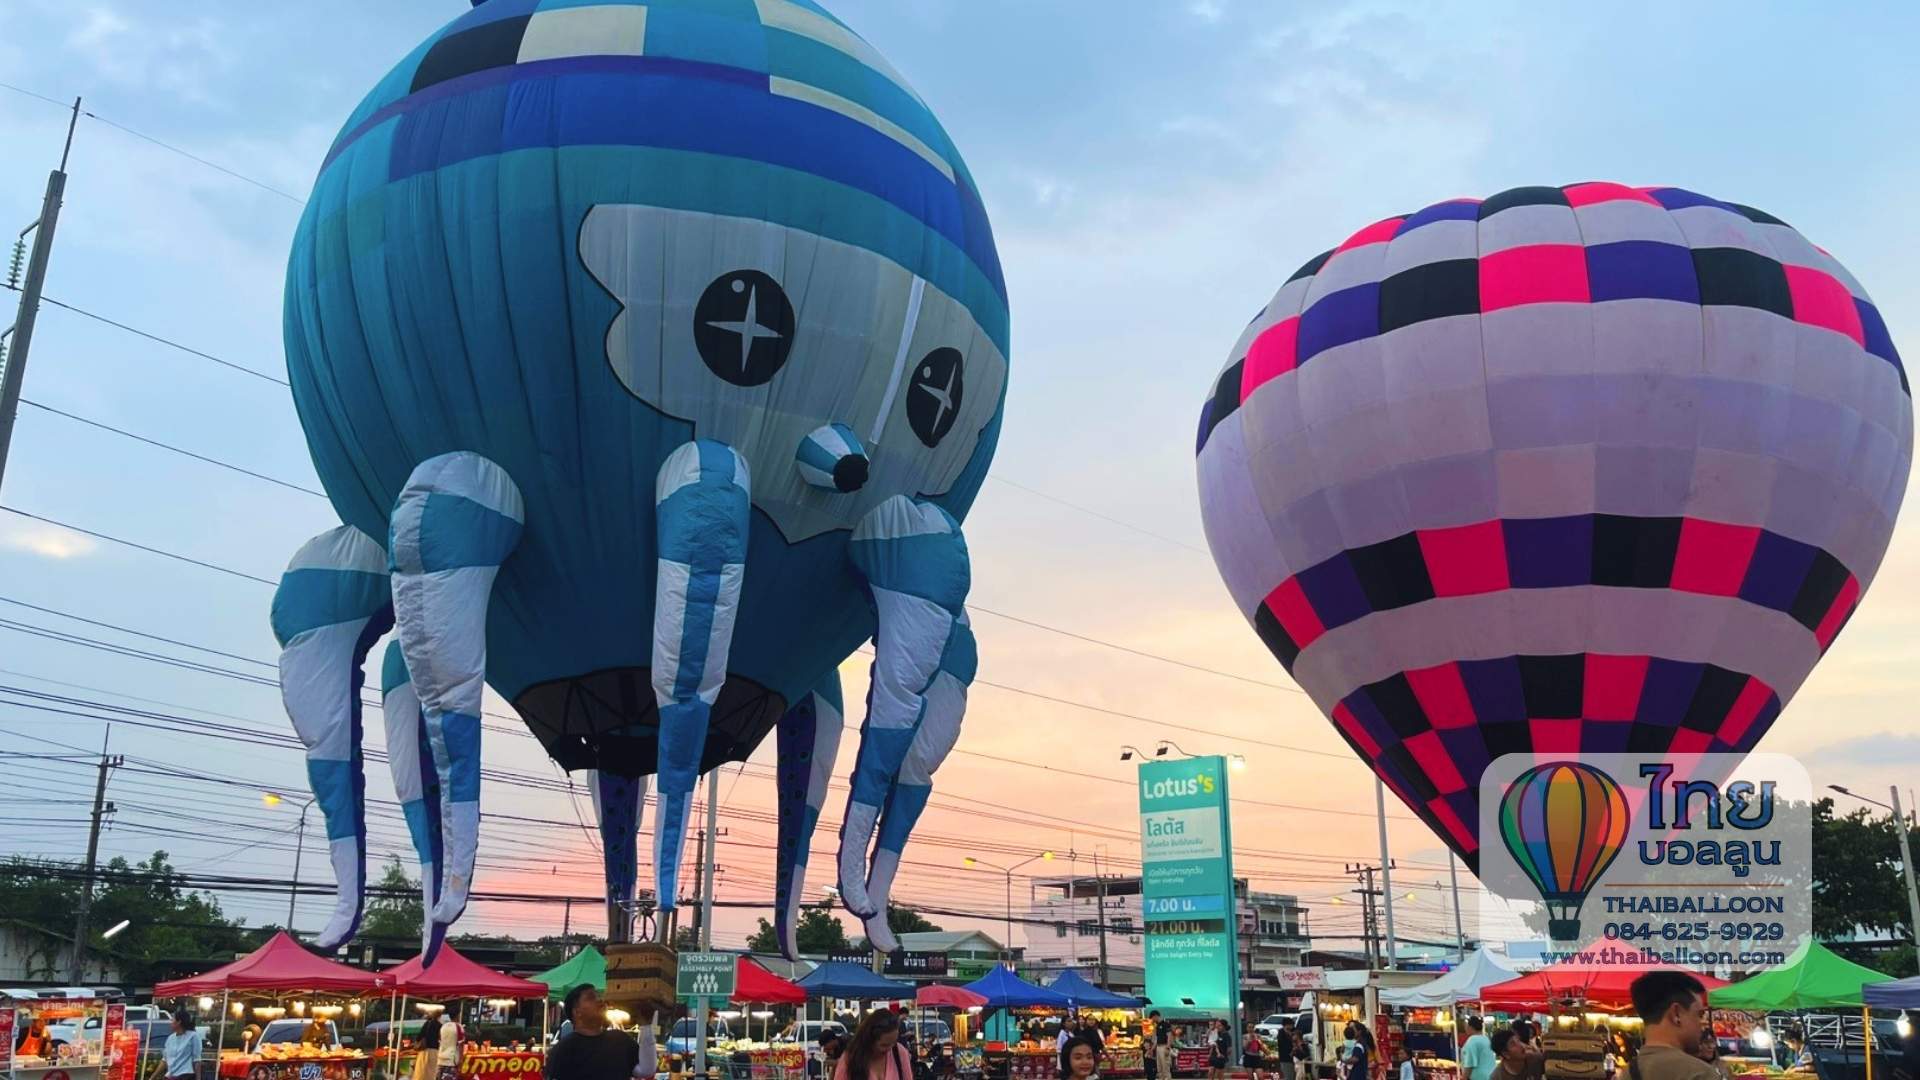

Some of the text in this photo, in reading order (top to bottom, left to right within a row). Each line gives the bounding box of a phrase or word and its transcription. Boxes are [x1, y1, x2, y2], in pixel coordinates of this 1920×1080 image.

[1144, 773, 1215, 799] Lotus's
[1146, 817, 1185, 837] โลตัส
[1148, 898, 1178, 913] 7.00
[1150, 921, 1187, 935] 21.00
